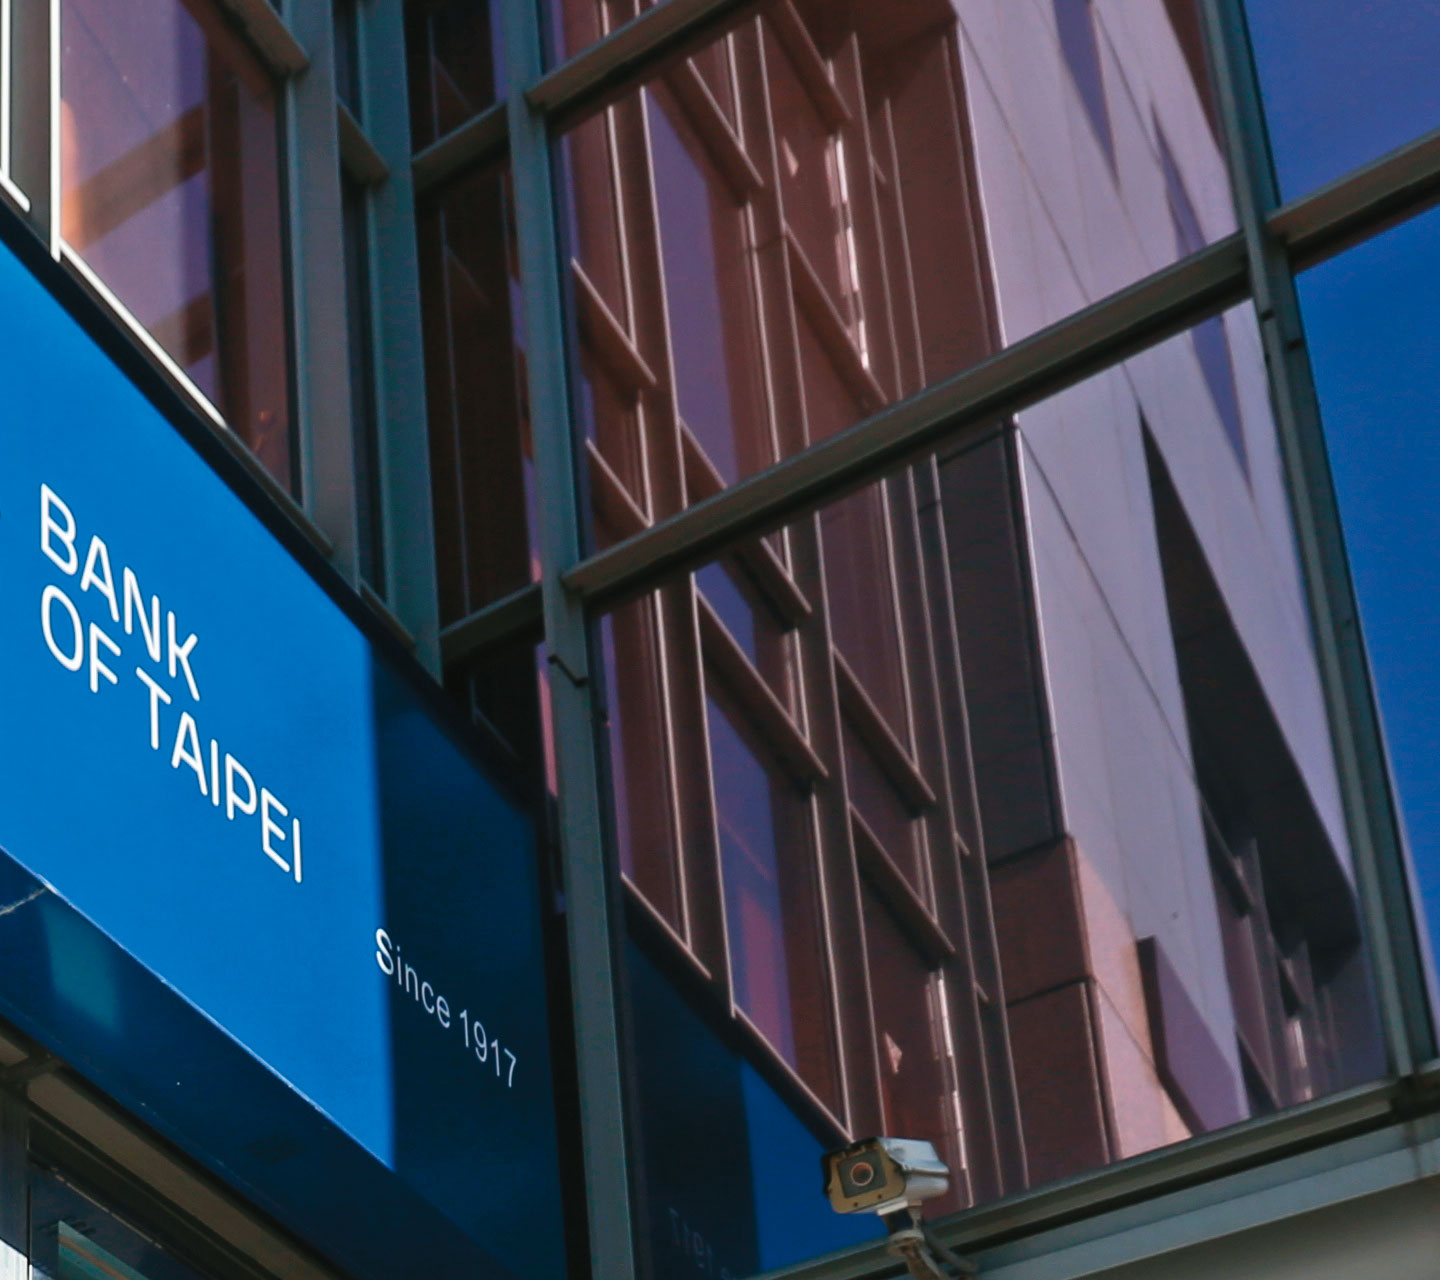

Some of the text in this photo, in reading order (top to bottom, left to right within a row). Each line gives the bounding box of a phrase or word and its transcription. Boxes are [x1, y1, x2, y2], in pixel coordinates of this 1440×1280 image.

[40, 483, 200, 701] BANK
[40, 584, 303, 883] OF TAIPEI
[376, 928, 518, 1088] Since 1917
